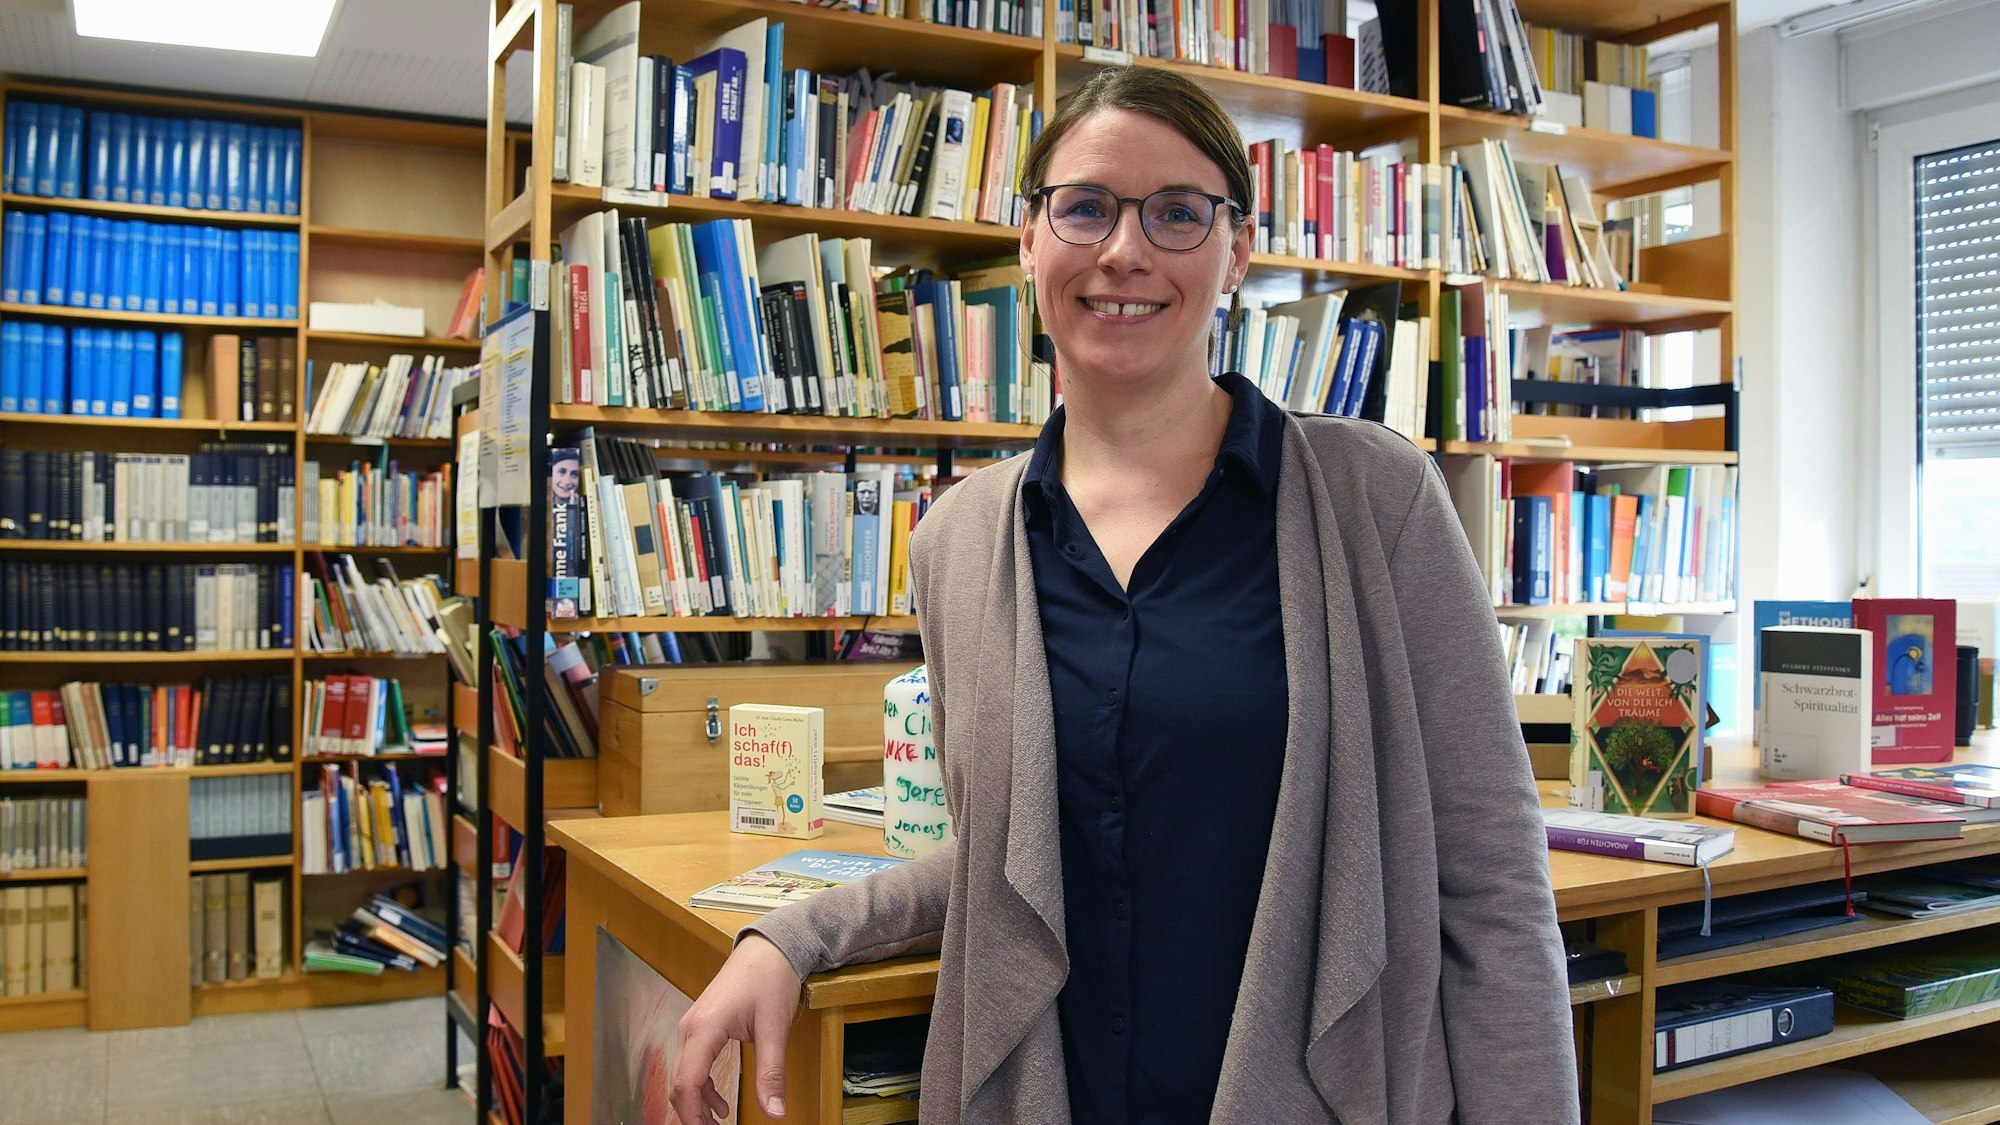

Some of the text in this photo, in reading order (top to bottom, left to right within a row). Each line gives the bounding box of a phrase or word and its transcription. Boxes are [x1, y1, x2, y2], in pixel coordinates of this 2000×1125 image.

[722, 82, 731, 104] ENDE
[729, 90, 738, 121] SCHAUT
[578, 290, 589, 314] 1918
[553, 503, 567, 578] nne Frank
[1779, 617, 1850, 628] METHODE
[1617, 688, 1664, 697] DIE WELT,
[1782, 683, 1858, 698] Schwarzbrot-
[1618, 708, 1660, 717] TRÄUME
[1793, 699, 1858, 714] Spiritualität
[1875, 714, 1893, 722] Alles
[1927, 712, 1941, 720] Zeit
[734, 723, 756, 737] Ich
[734, 739, 792, 758] schaf(f)
[734, 753, 765, 767] das!
[734, 783, 768, 791] Körperübungen
[1576, 837, 1590, 847] FÜR
[1590, 839, 1629, 850] ANDACHTEN
[801, 857, 872, 867] WARUM
